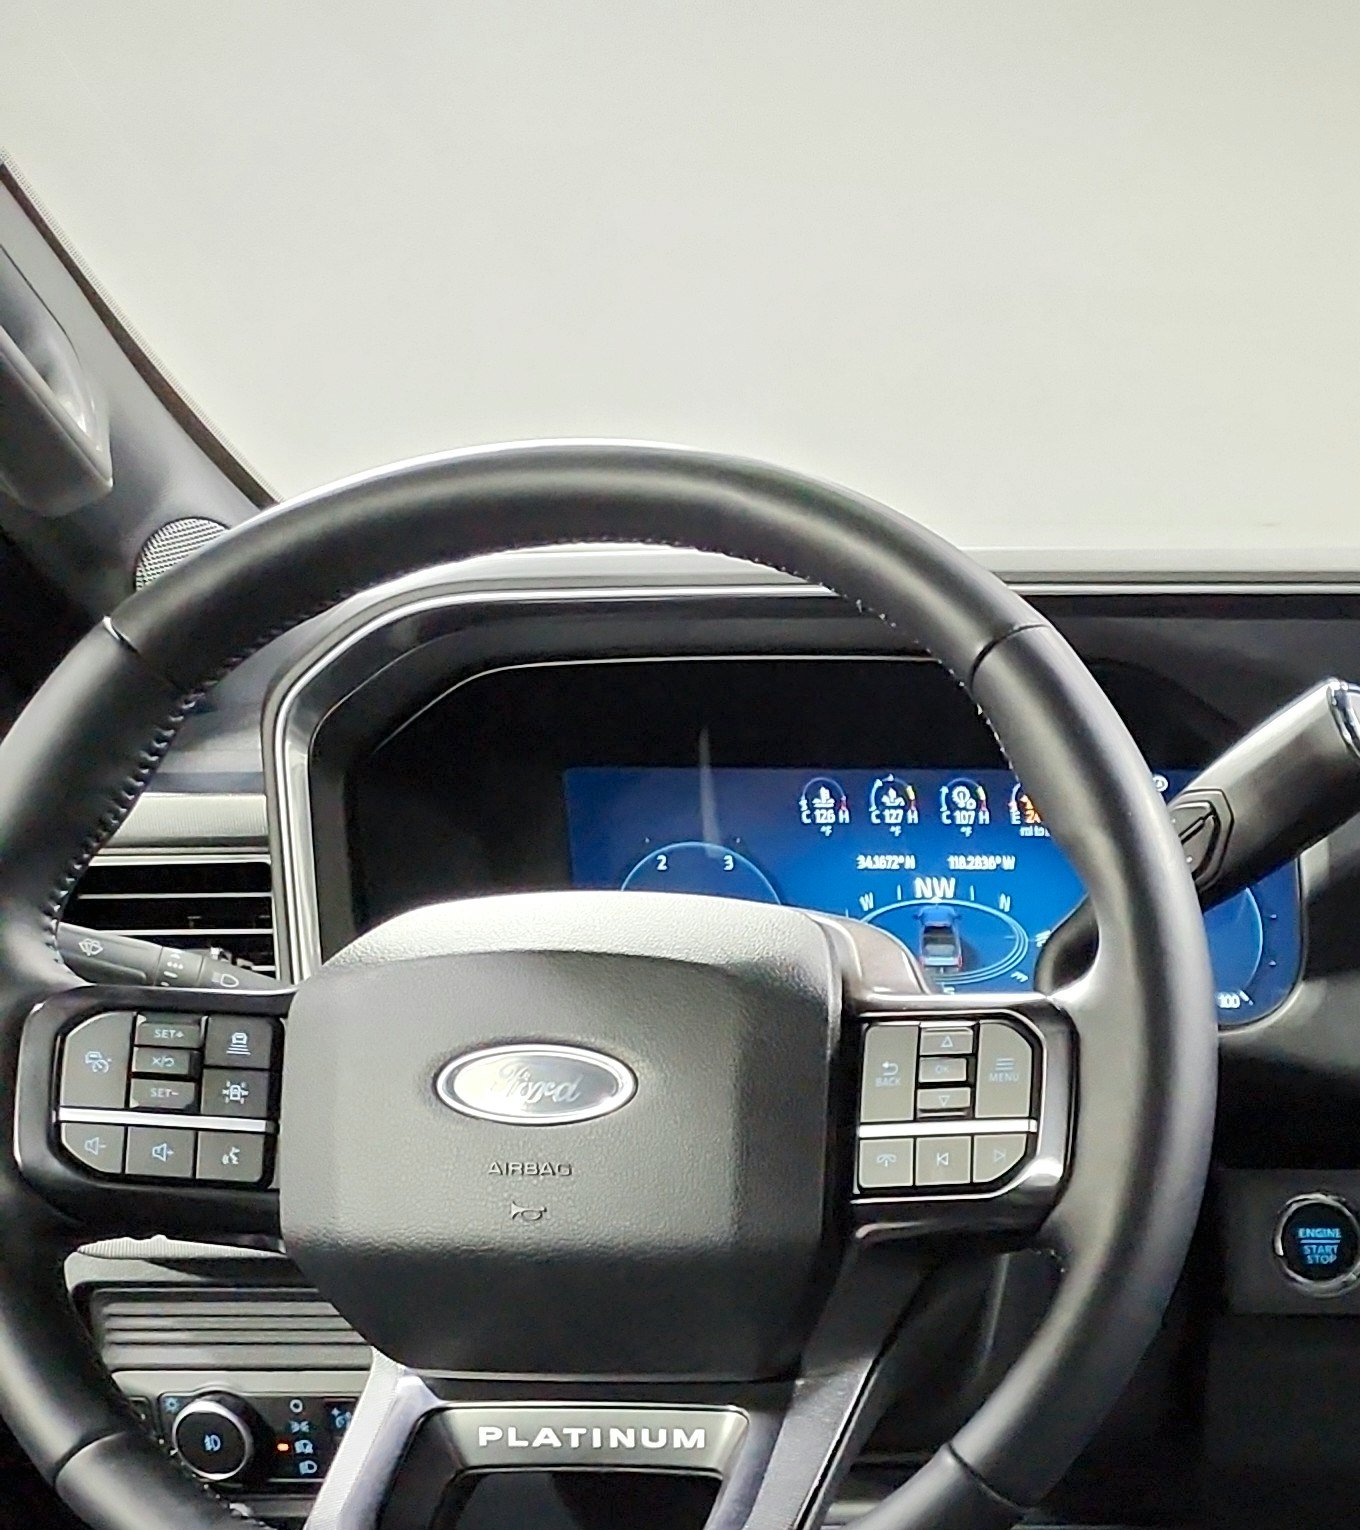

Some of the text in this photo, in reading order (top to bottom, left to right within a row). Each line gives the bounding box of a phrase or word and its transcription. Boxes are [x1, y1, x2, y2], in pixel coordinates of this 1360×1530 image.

[656, 854, 668, 871] 2
[723, 854, 735, 871] 3
[914, 876, 957, 899] NW
[496, 1061, 584, 1104] Ford
[988, 1071, 1019, 1083] MENU
[488, 1160, 573, 1177] AIRBAG
[1297, 1227, 1342, 1239] ENGINE
[1303, 1244, 1339, 1256] START
[1306, 1254, 1337, 1265] STOP
[478, 1426, 706, 1449] PLATINUM
